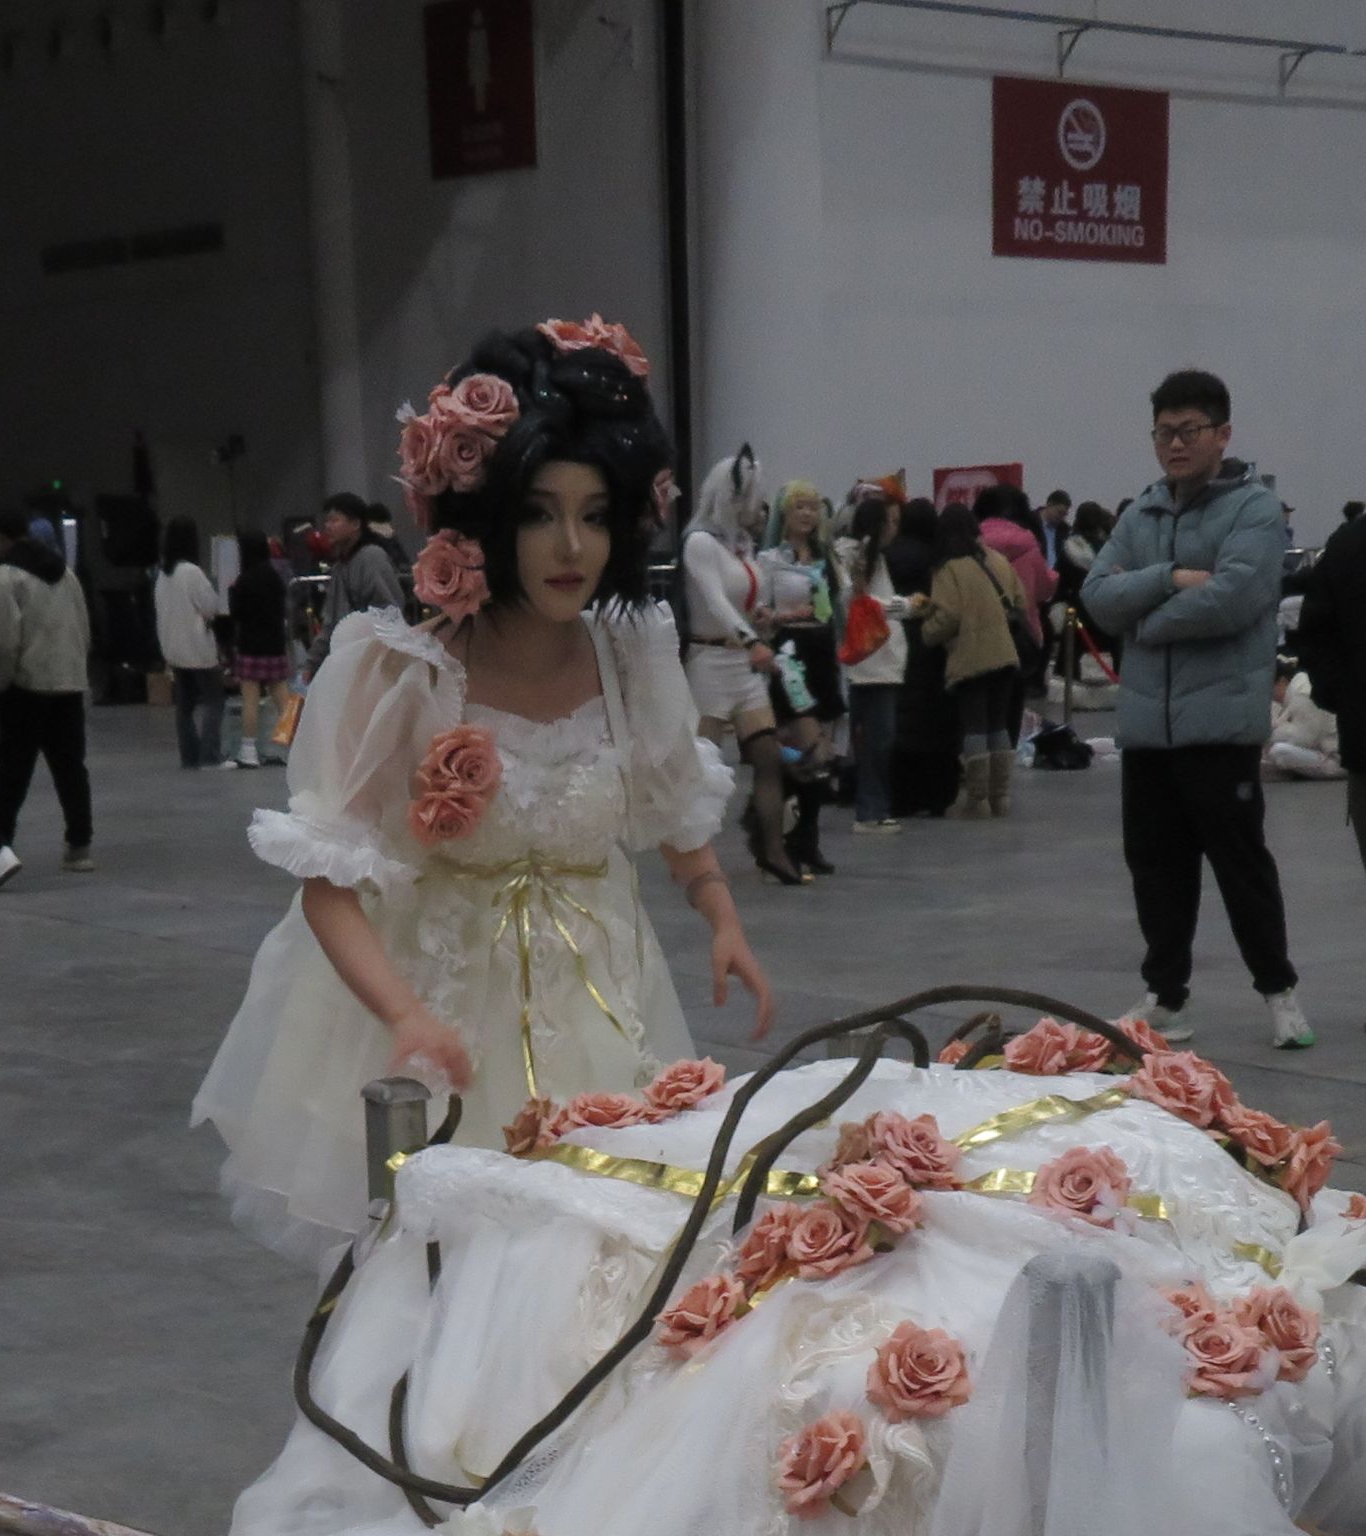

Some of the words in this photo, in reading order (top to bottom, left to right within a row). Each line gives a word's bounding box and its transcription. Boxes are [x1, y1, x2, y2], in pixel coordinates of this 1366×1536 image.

[1017, 176, 1142, 223] 禁止吸烟
[1014, 218, 1145, 248] NO-SMOKING
